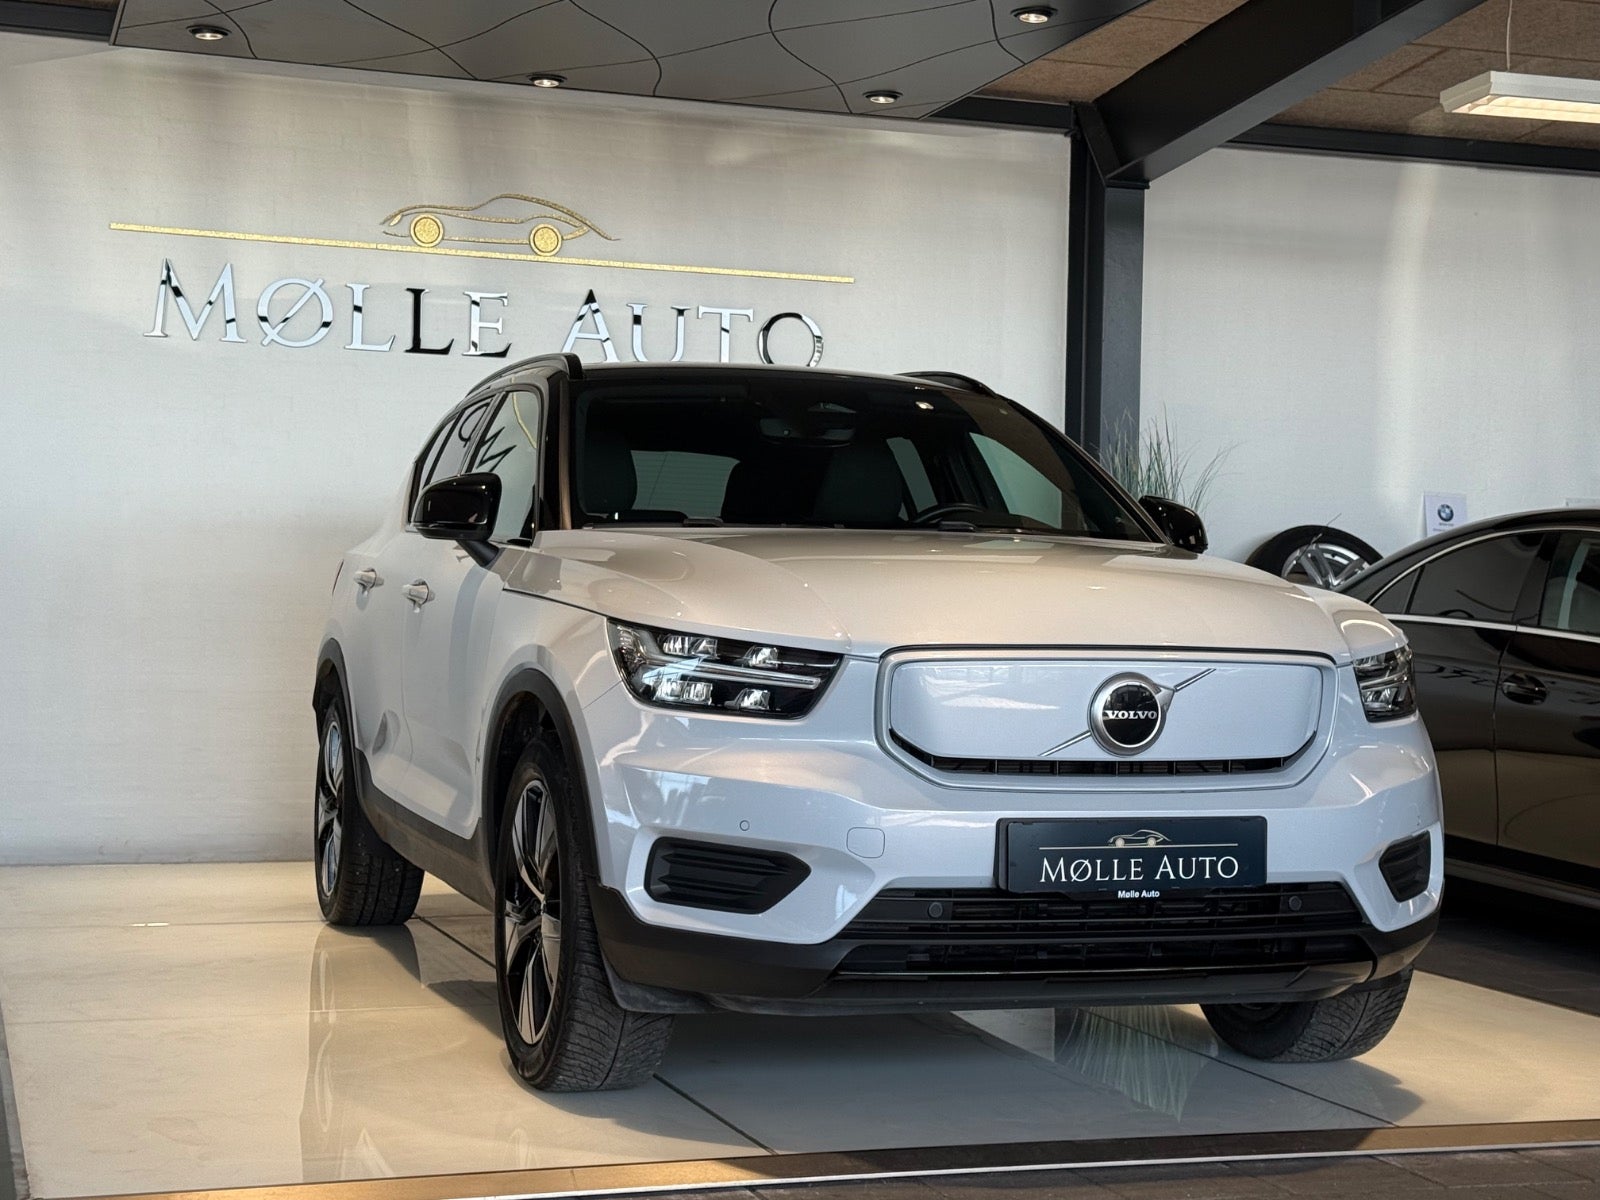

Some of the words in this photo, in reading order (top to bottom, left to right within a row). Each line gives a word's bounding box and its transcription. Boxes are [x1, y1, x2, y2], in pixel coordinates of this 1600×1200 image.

[143, 257, 512, 358] MØLLE
[561, 288, 824, 367] AUTO
[1103, 710, 1158, 720] VOLVO
[1039, 857, 1145, 883] MØLLE
[1154, 855, 1239, 880] AUTO
[1140, 889, 1160, 898] Auto
